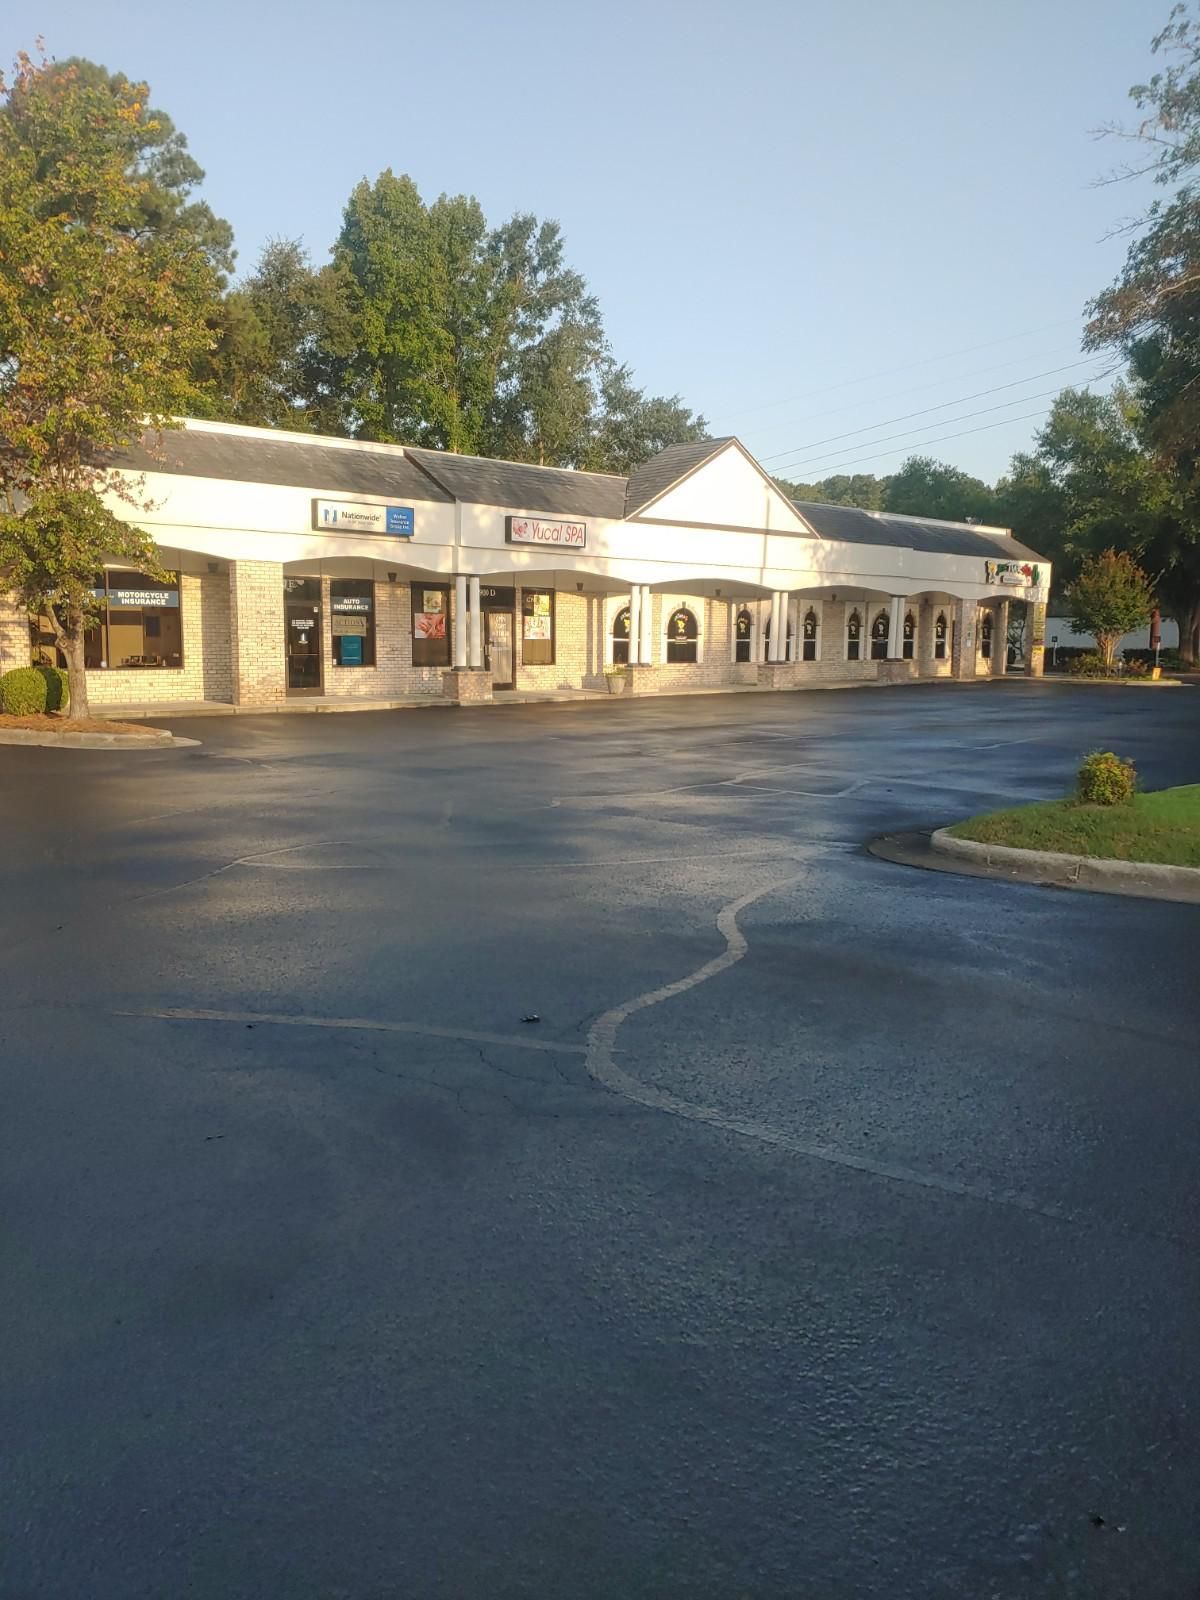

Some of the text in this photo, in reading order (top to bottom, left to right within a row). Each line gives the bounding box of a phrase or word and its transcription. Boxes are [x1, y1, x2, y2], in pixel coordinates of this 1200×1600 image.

[341, 511, 380, 522] Nationwide
[532, 522, 584, 544] Yucal SPA
[117, 591, 169, 599] MOTORCYCLE
